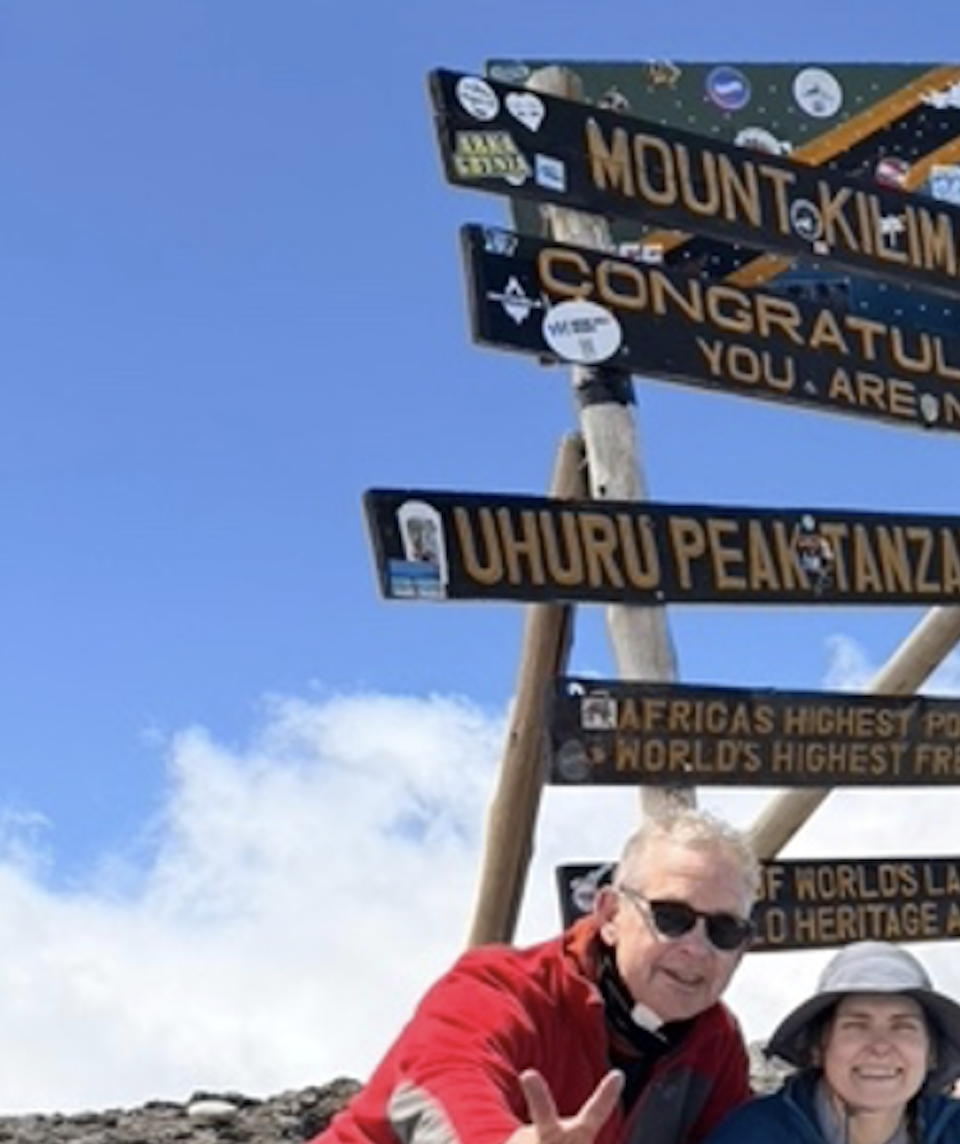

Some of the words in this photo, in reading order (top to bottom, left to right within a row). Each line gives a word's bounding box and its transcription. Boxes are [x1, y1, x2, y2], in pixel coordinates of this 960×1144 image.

[586, 116, 795, 236] MOUNT
[698, 335, 796, 390] YOU
[828, 367, 917, 416] ARE
[453, 506, 661, 590] UHURU
[784, 706, 910, 737] HIGHEST
[615, 738, 762, 772] WORLD'S
[772, 741, 907, 775] HIGHEST
[795, 900, 939, 942] HERITAGE
